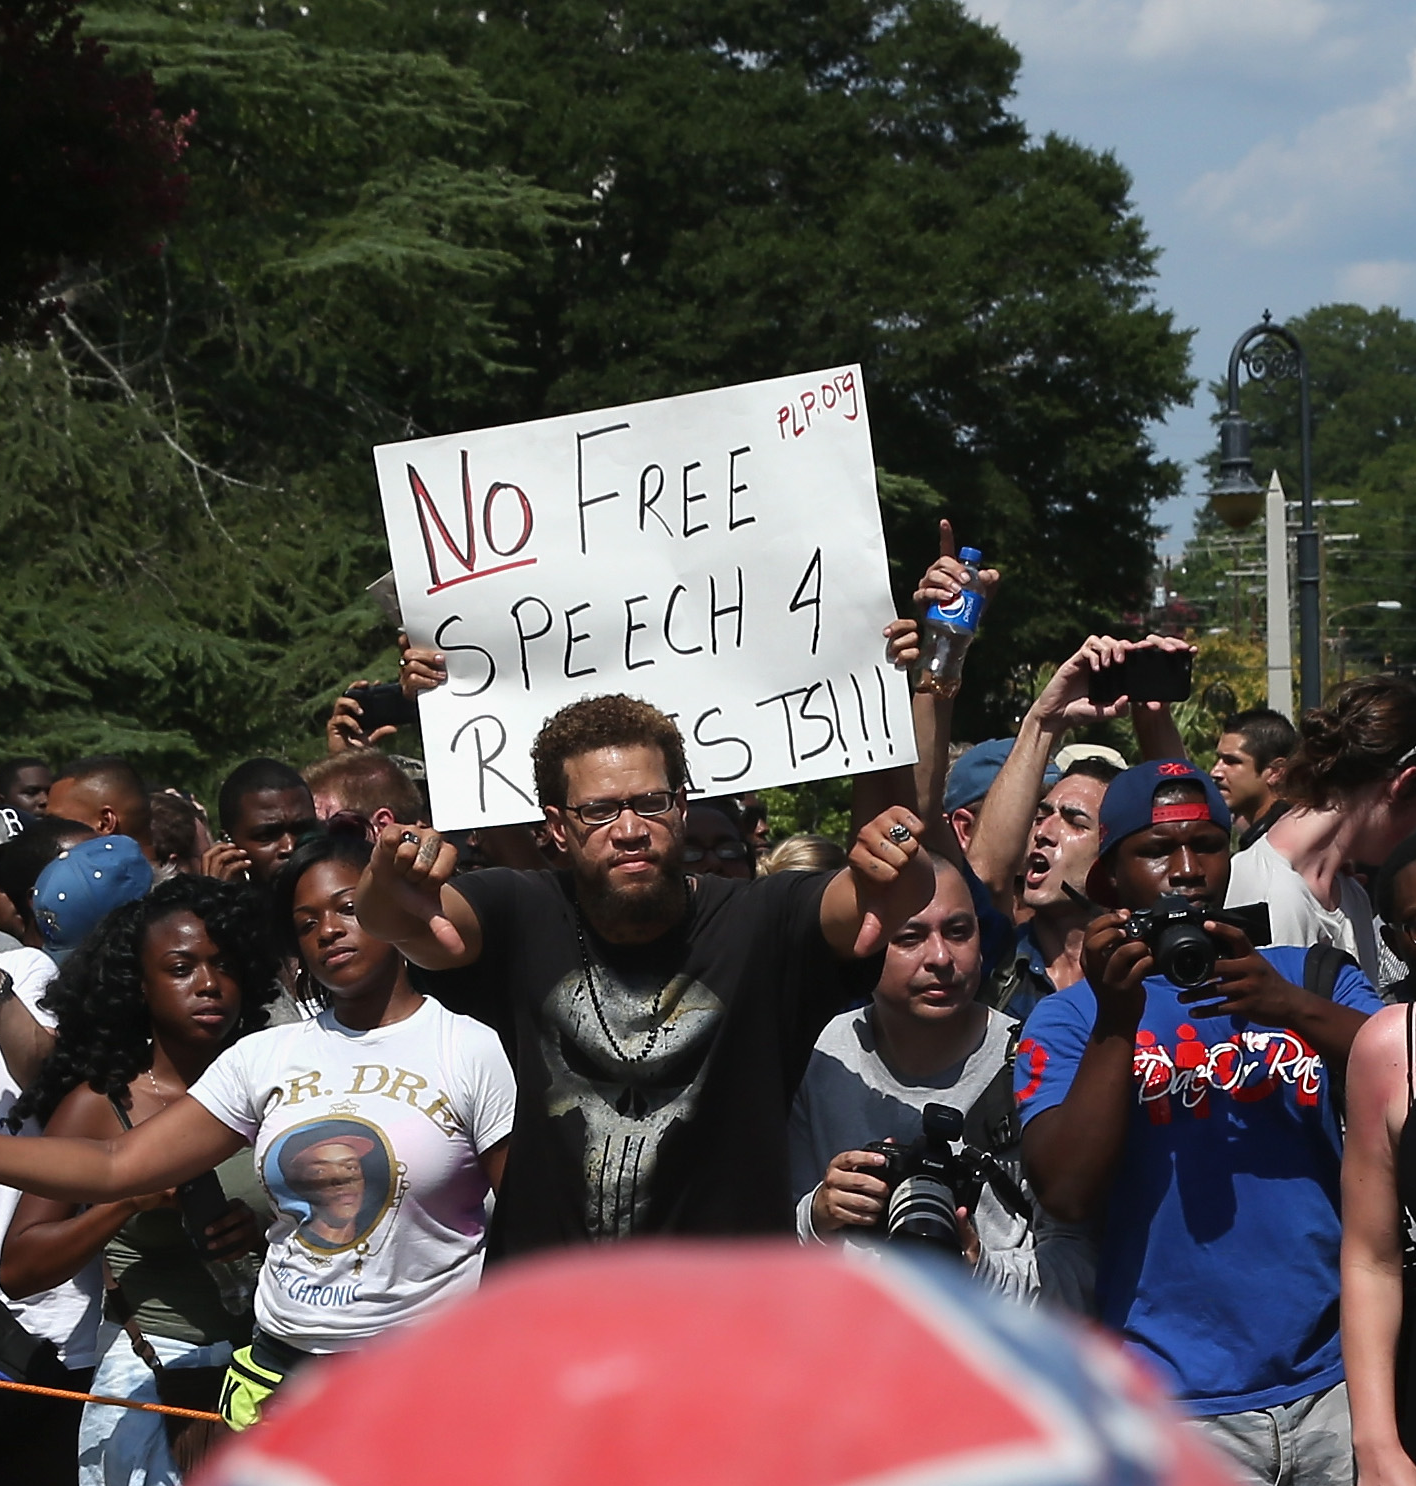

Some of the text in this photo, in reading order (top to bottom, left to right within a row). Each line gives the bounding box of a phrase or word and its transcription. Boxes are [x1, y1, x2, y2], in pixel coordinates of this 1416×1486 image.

[576, 422, 757, 554] FREE
[435, 546, 822, 697] SPEECH 4
[450, 665, 895, 812] RISTS!!!
[343, 1064, 456, 1138] DRE
[288, 1276, 363, 1306] CHRONIC
